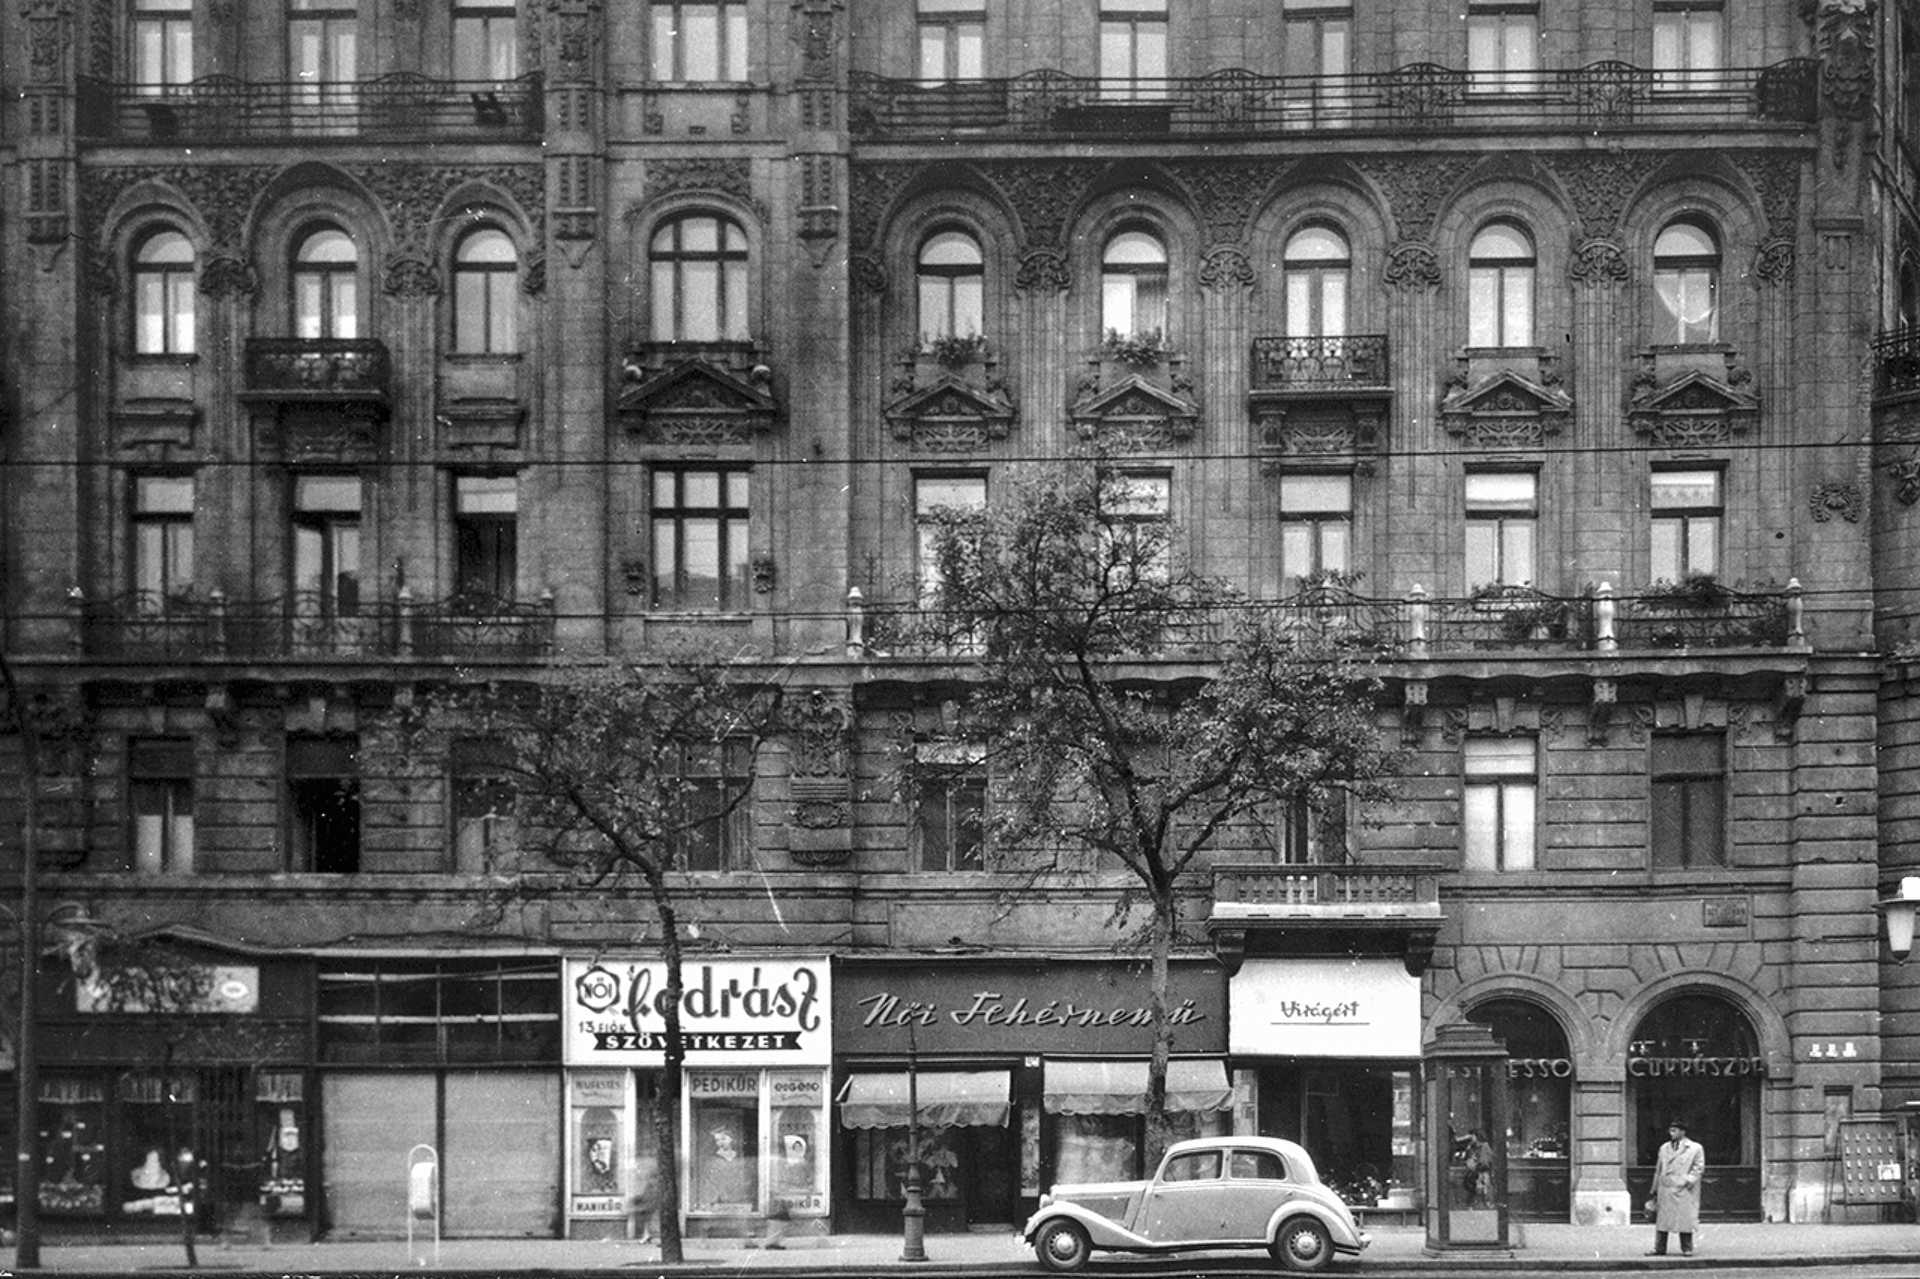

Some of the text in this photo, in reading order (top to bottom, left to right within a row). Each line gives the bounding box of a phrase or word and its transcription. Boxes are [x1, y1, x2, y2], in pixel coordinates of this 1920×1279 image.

[858, 991, 1206, 1028] Női Fehérnemű
[1280, 1001, 1361, 1024] Virágért
[579, 1021, 595, 1034] 13
